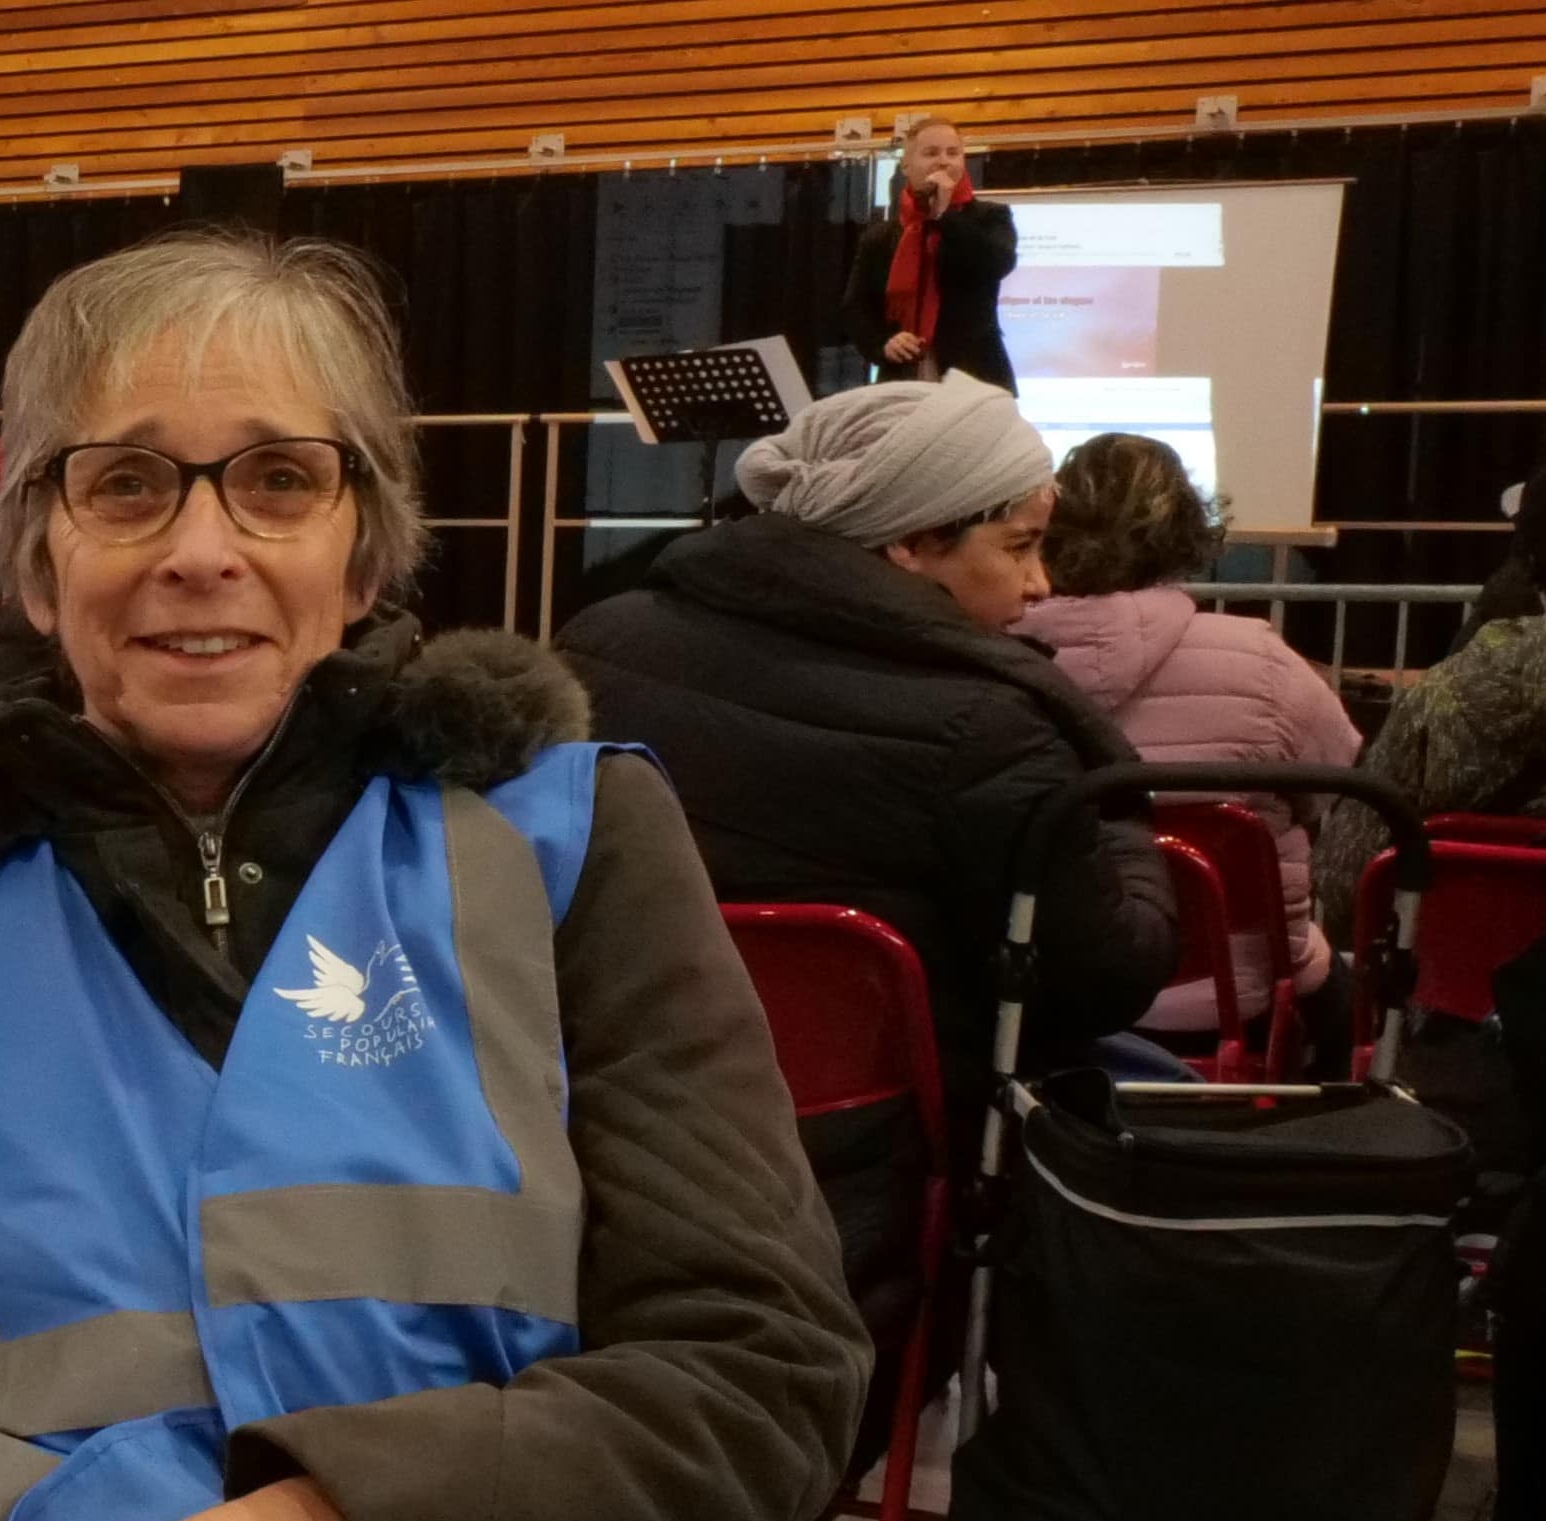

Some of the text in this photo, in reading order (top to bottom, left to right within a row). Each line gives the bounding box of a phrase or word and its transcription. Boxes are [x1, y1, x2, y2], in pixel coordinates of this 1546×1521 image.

[303, 1001, 421, 1039] SECOURS
[340, 1015, 436, 1051] POPULAIR
[318, 1033, 424, 1068] FRANÇAIS
